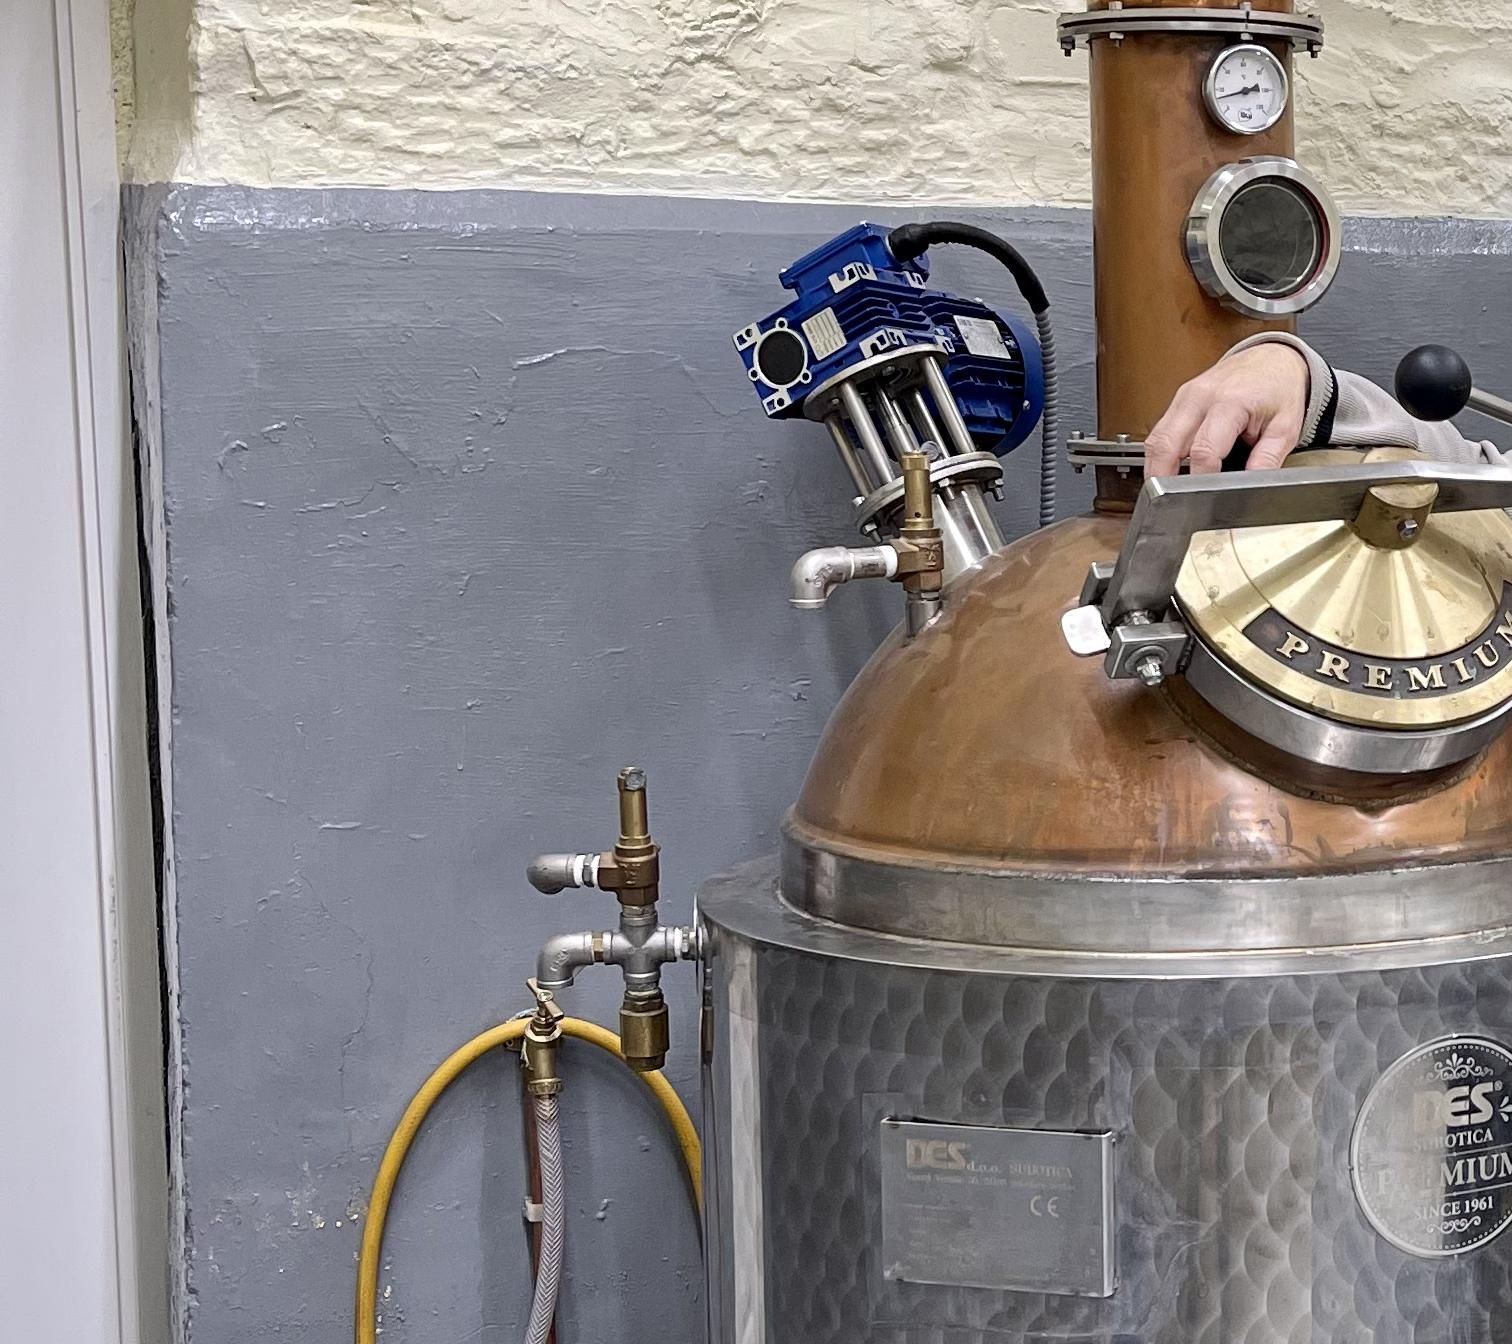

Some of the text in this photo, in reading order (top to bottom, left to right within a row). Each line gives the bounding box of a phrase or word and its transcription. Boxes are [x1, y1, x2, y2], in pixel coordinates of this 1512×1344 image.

[1414, 1082, 1494, 1129] DES
[906, 1138, 967, 1170] DES
[1414, 1195, 1494, 1221] SINCE 1961
